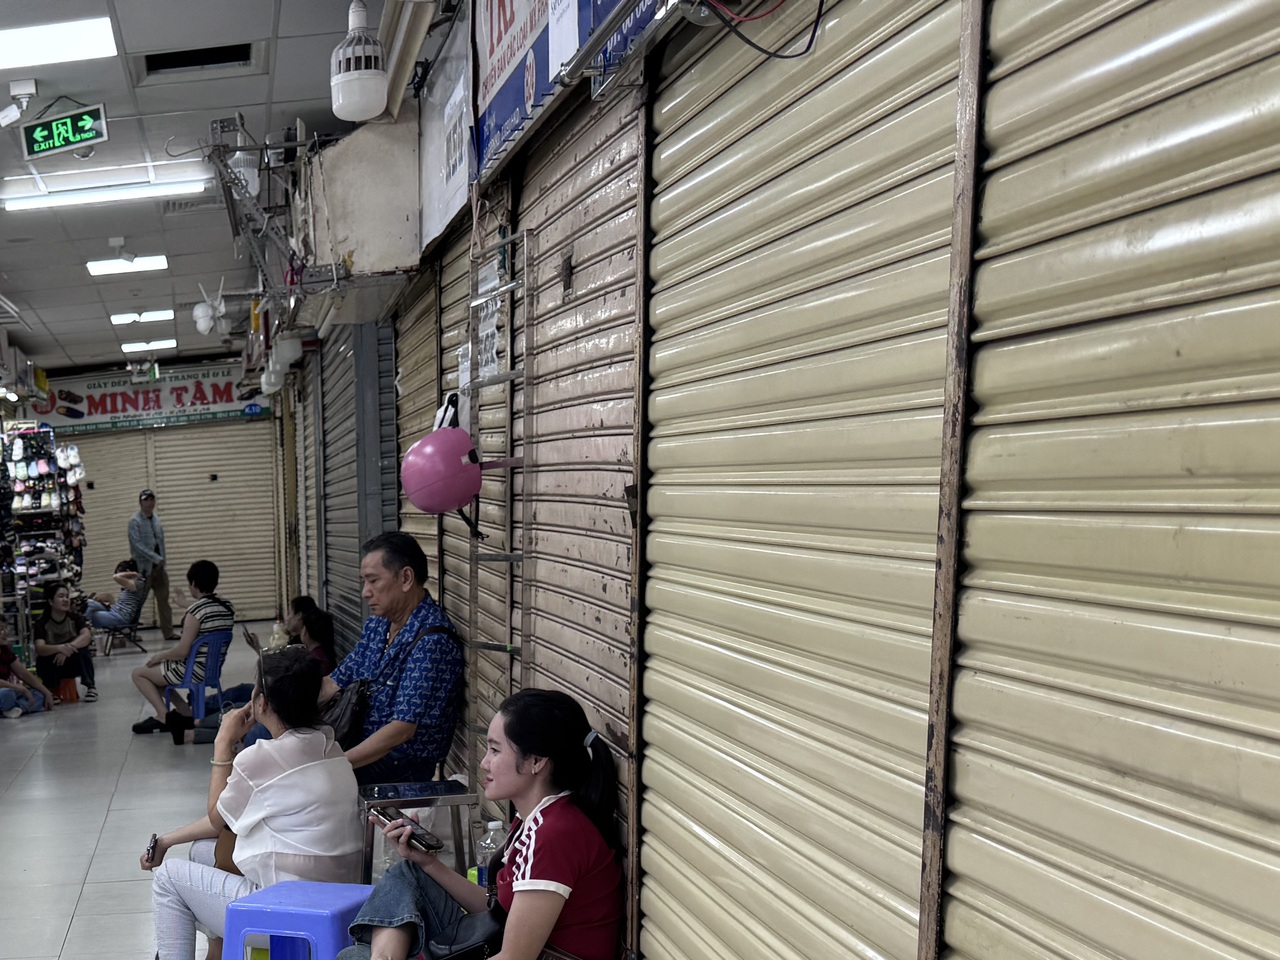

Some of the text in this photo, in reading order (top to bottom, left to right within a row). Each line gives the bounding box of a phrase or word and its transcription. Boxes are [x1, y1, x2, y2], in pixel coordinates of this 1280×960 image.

[33, 140, 55, 152] EXIT
[87, 381, 108, 390] GIÀY
[111, 379, 128, 388] DÉP
[168, 373, 199, 382] TRANG
[86, 388, 162, 416] MINH
[169, 380, 235, 408] TÂM
